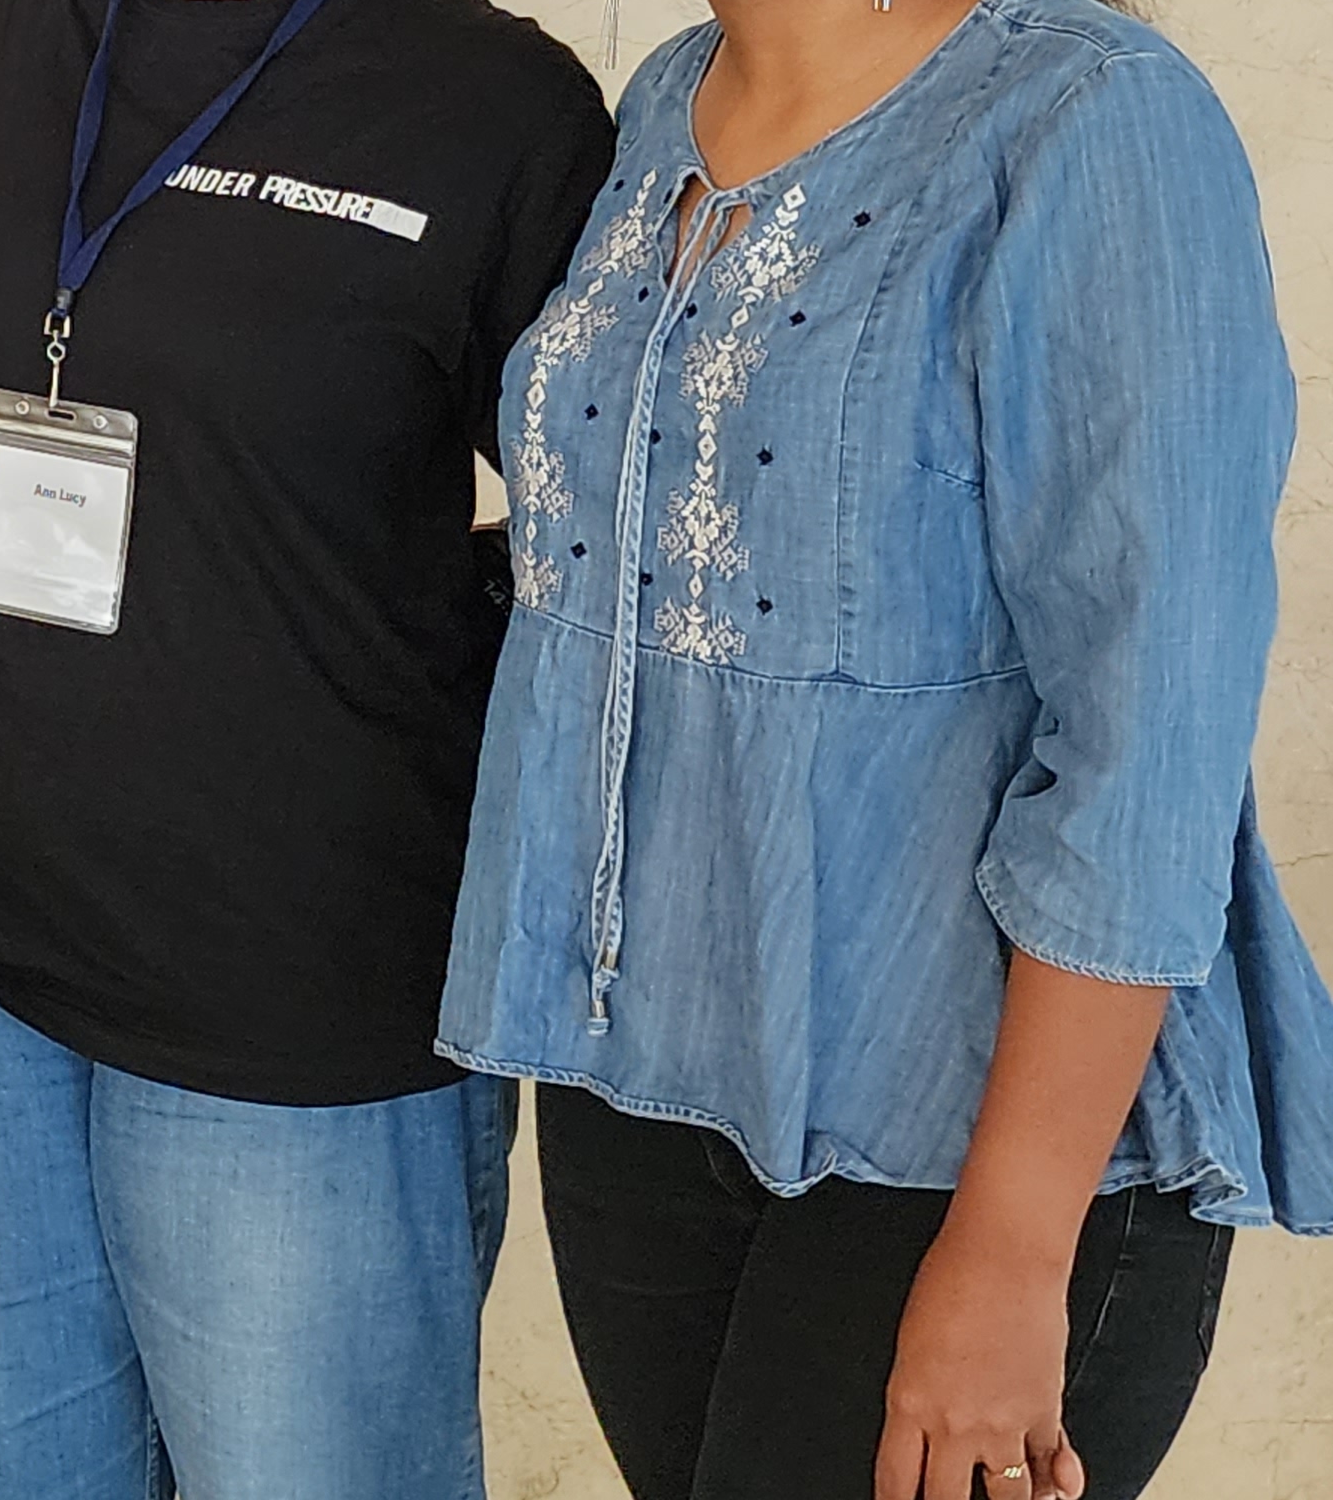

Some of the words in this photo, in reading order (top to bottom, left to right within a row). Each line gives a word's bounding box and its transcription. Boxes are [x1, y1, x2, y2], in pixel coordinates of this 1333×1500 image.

[164, 164, 256, 196] UNDER
[259, 175, 379, 221] PRESSURE
[34, 484, 57, 500] Ann
[60, 488, 86, 507] Lucy
